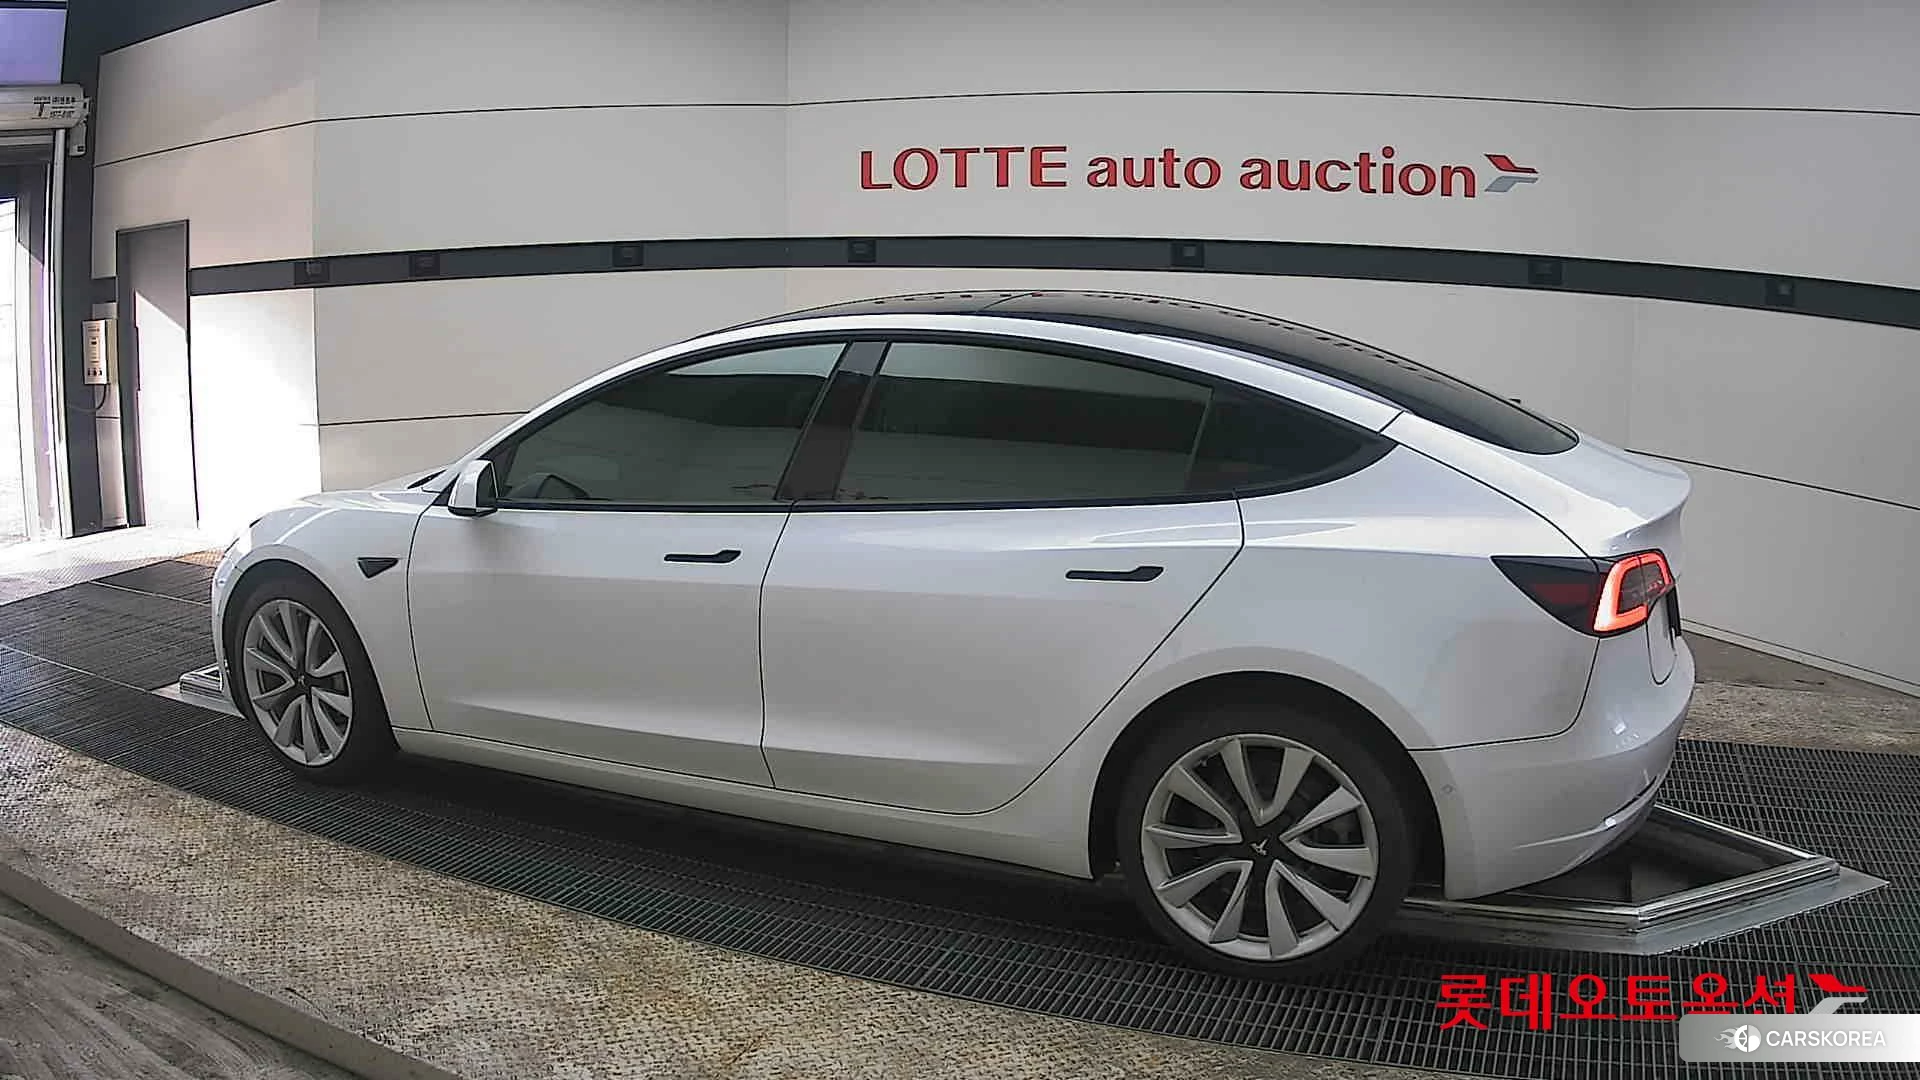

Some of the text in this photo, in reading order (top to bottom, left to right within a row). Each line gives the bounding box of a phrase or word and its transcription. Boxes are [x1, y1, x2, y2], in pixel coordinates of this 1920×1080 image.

[860, 146, 1477, 198] LOTTE auto auction
